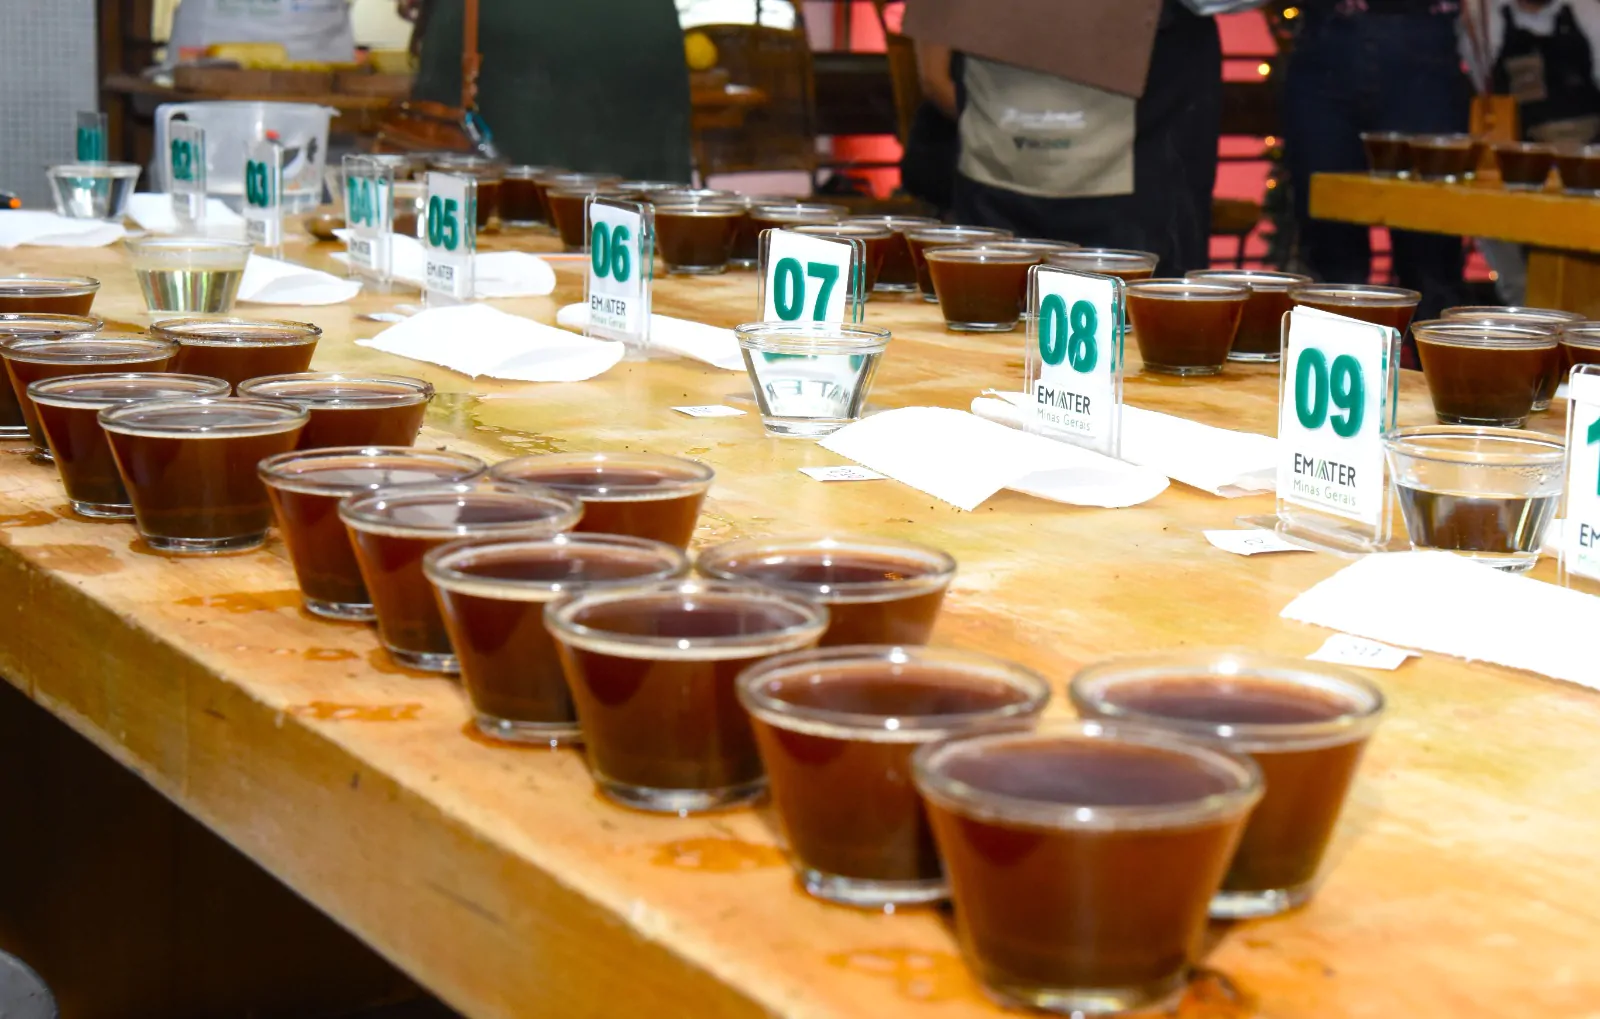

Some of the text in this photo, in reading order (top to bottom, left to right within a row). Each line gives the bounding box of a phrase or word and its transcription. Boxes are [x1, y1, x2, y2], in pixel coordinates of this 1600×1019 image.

[246, 159, 269, 208] 03
[428, 195, 459, 252] 05
[591, 221, 631, 283] 06
[591, 295, 626, 316] EMATER
[773, 257, 840, 322] 07
[1038, 293, 1098, 374] 08
[1037, 385, 1091, 416] EMATER
[1295, 347, 1365, 438] 09
[1037, 408, 1091, 431] Minas Gerais
[1293, 479, 1356, 506] Minas Gerais
[1294, 452, 1356, 488] EMATER
